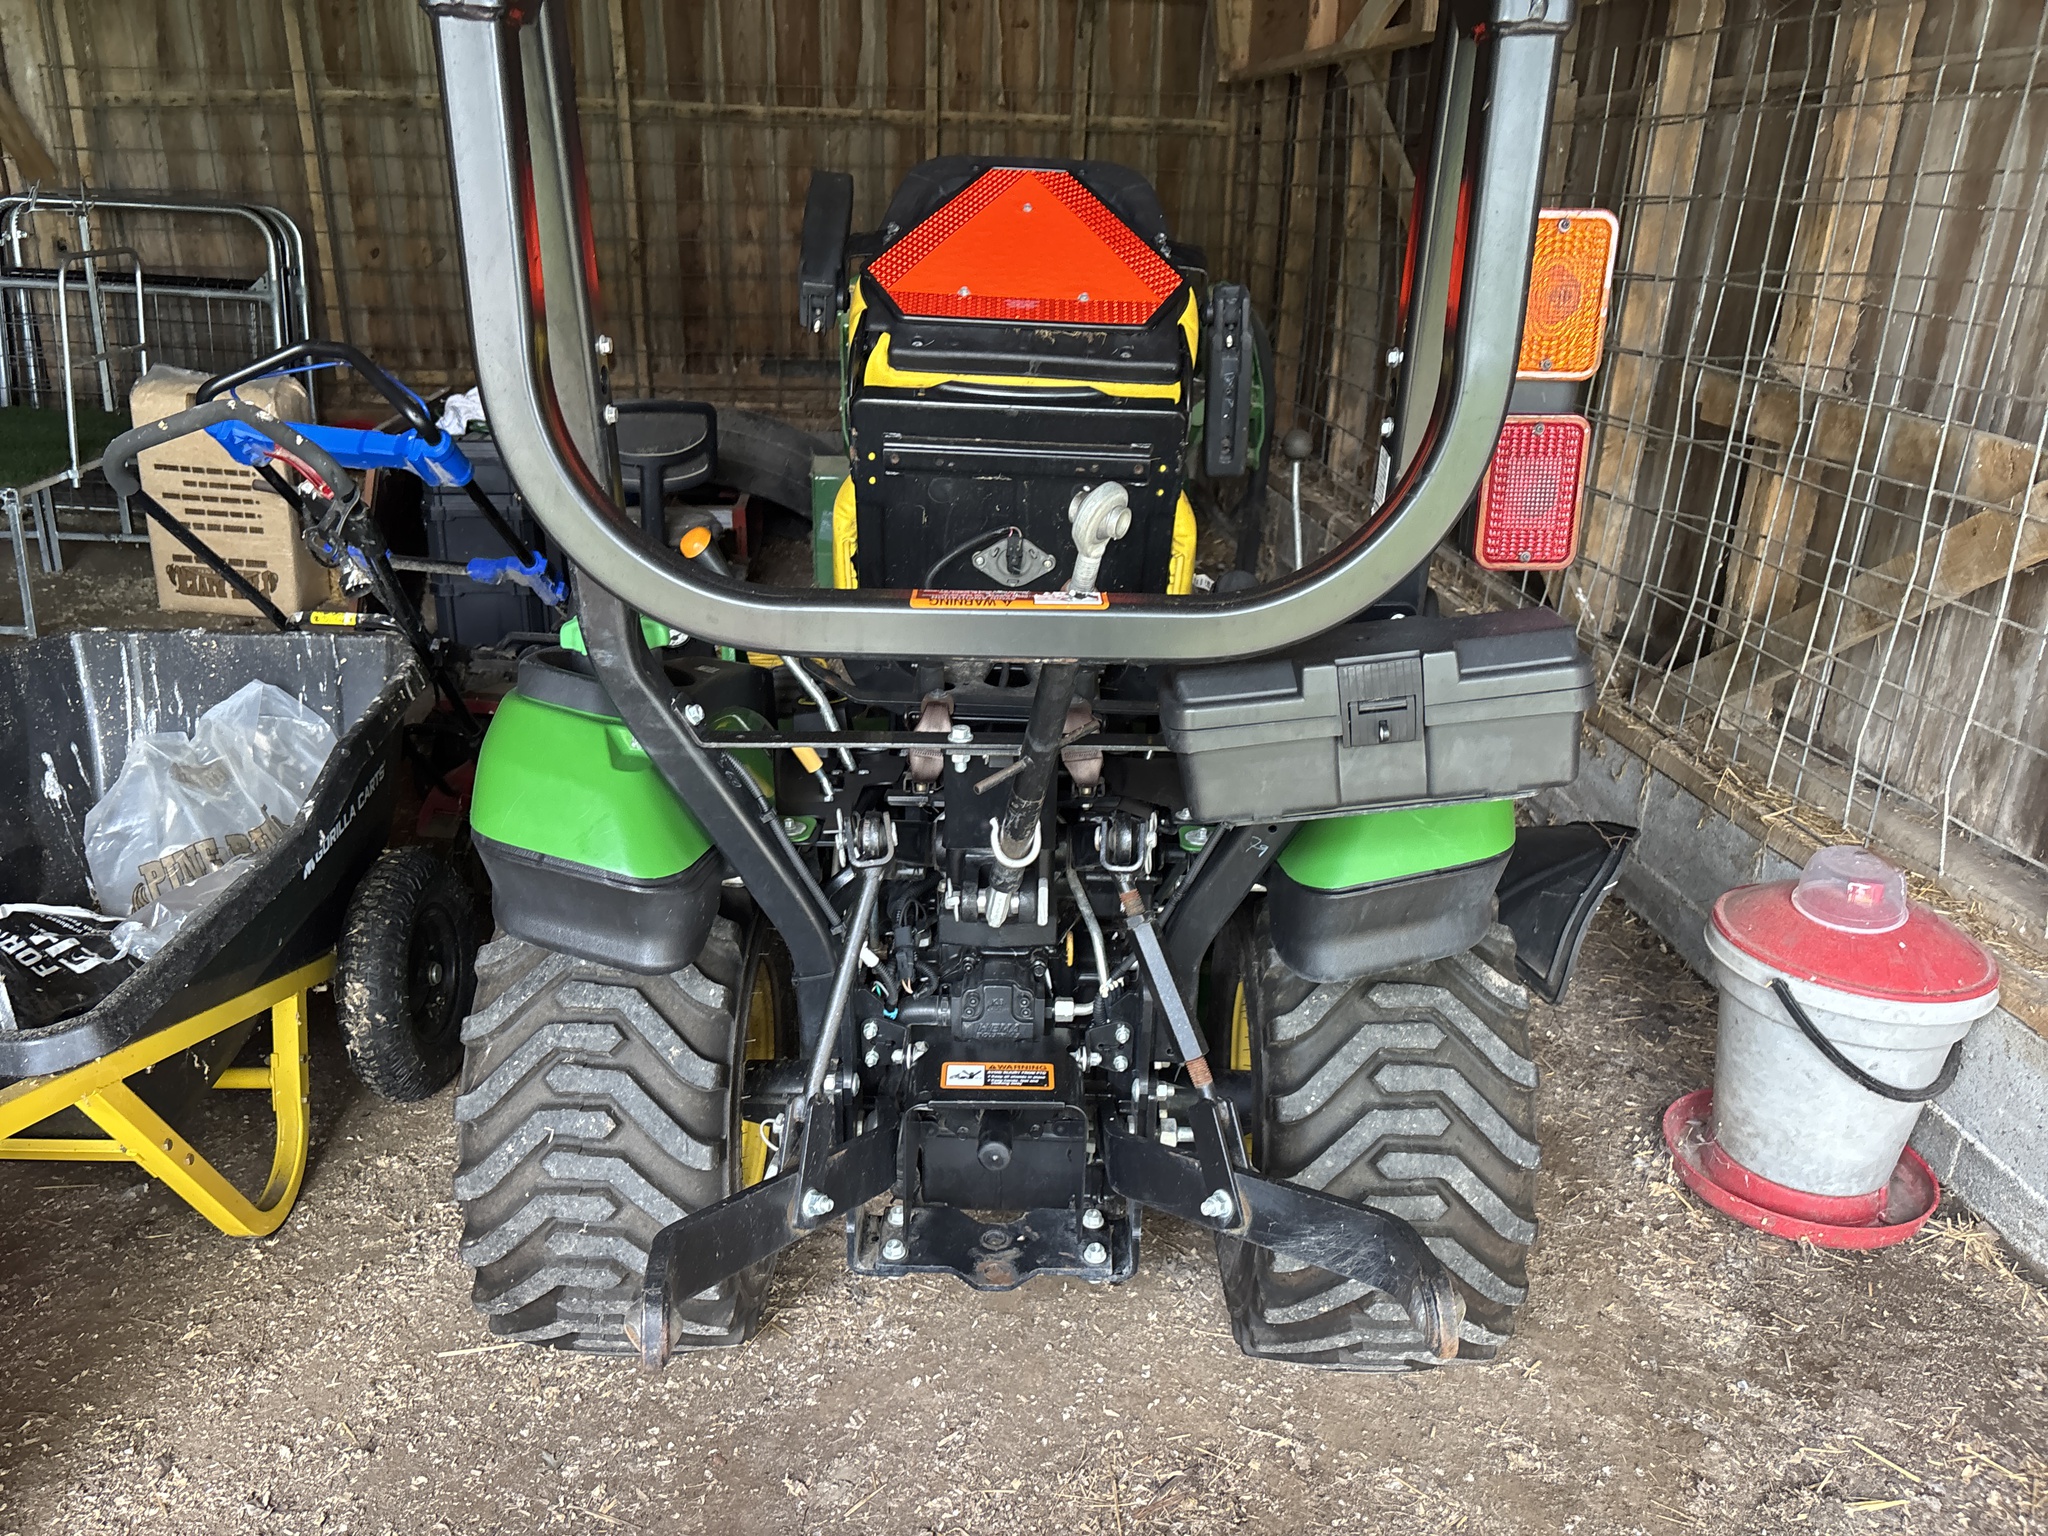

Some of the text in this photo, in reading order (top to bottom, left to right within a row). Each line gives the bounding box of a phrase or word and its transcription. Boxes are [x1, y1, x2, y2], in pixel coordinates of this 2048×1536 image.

[929, 598, 997, 606] WARNING
[315, 765, 386, 864] GORILLA CARTS
